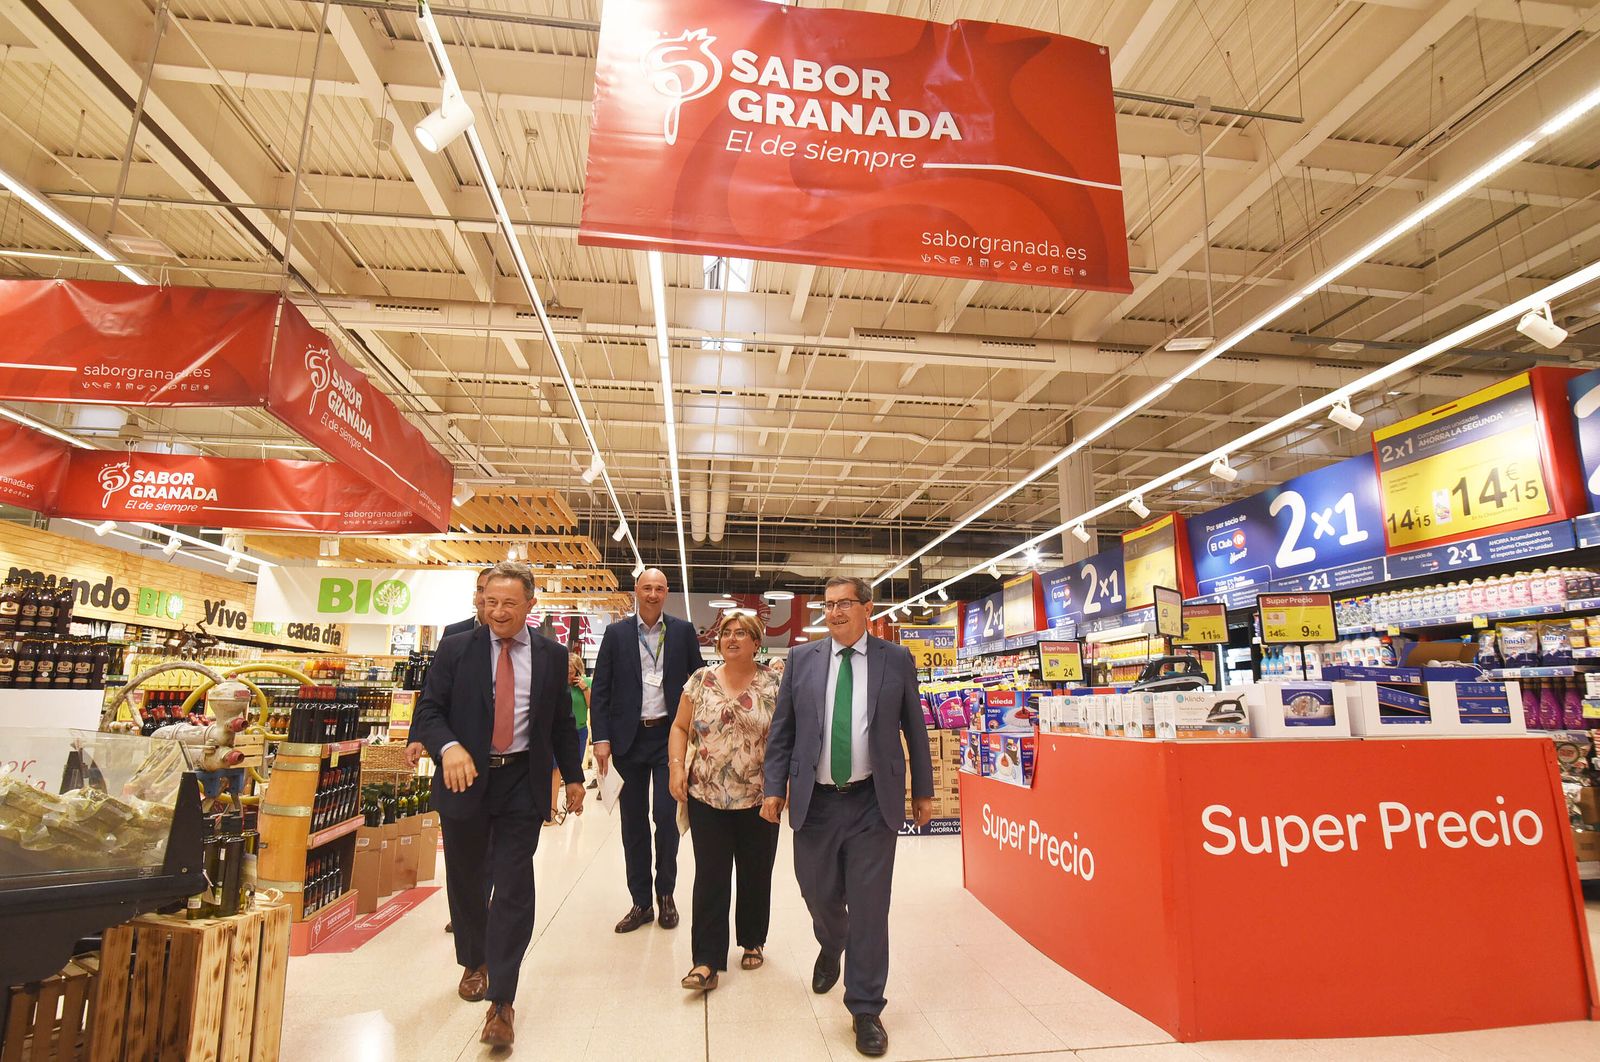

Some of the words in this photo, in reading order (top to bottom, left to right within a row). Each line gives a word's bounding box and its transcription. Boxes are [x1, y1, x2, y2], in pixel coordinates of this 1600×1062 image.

[729, 48, 892, 101] SABOR
[727, 88, 962, 141] GRANADA
[725, 130, 753, 153] El
[760, 134, 797, 157] de
[805, 142, 917, 172] siempre
[921, 229, 1088, 261] saborgranada.es
[331, 369, 362, 411] SABOR
[320, 412, 328, 427] El
[328, 418, 339, 433] de
[339, 427, 362, 452] siempre
[327, 390, 373, 443] GRANADA
[1381, 437, 1414, 463] 2x1
[1418, 432, 1451, 448] AHORRA
[1451, 428, 1463, 436] LA
[129, 484, 219, 502] GRANADA
[131, 469, 195, 486] SABOR
[125, 501, 136, 510] El
[138, 501, 154, 511] de
[156, 503, 199, 512] siempre
[1269, 490, 1369, 569] 2x1
[1210, 542, 1218, 552] El
[1447, 542, 1482, 565] 2x1
[317, 577, 411, 615] BIO
[1081, 563, 1123, 615] 2x1
[1307, 572, 1331, 591] 2x1
[137, 586, 185, 621] BIO
[1266, 597, 1289, 605] Super
[1289, 595, 1314, 604] Precio
[204, 599, 247, 631] Vive
[287, 621, 319, 642] cada
[321, 622, 342, 647] día
[903, 630, 920, 639] 2x1
[983, 600, 1004, 638] 2x1
[1301, 625, 1310, 637] 9
[934, 636, 947, 647] 30
[923, 652, 943, 667] 30
[943, 658, 954, 667] 30
[990, 697, 1013, 705] vileda
[982, 803, 1027, 851] Super
[1028, 819, 1095, 881] Precio
[1200, 804, 1367, 867] Super
[1378, 795, 1544, 851] Precio
